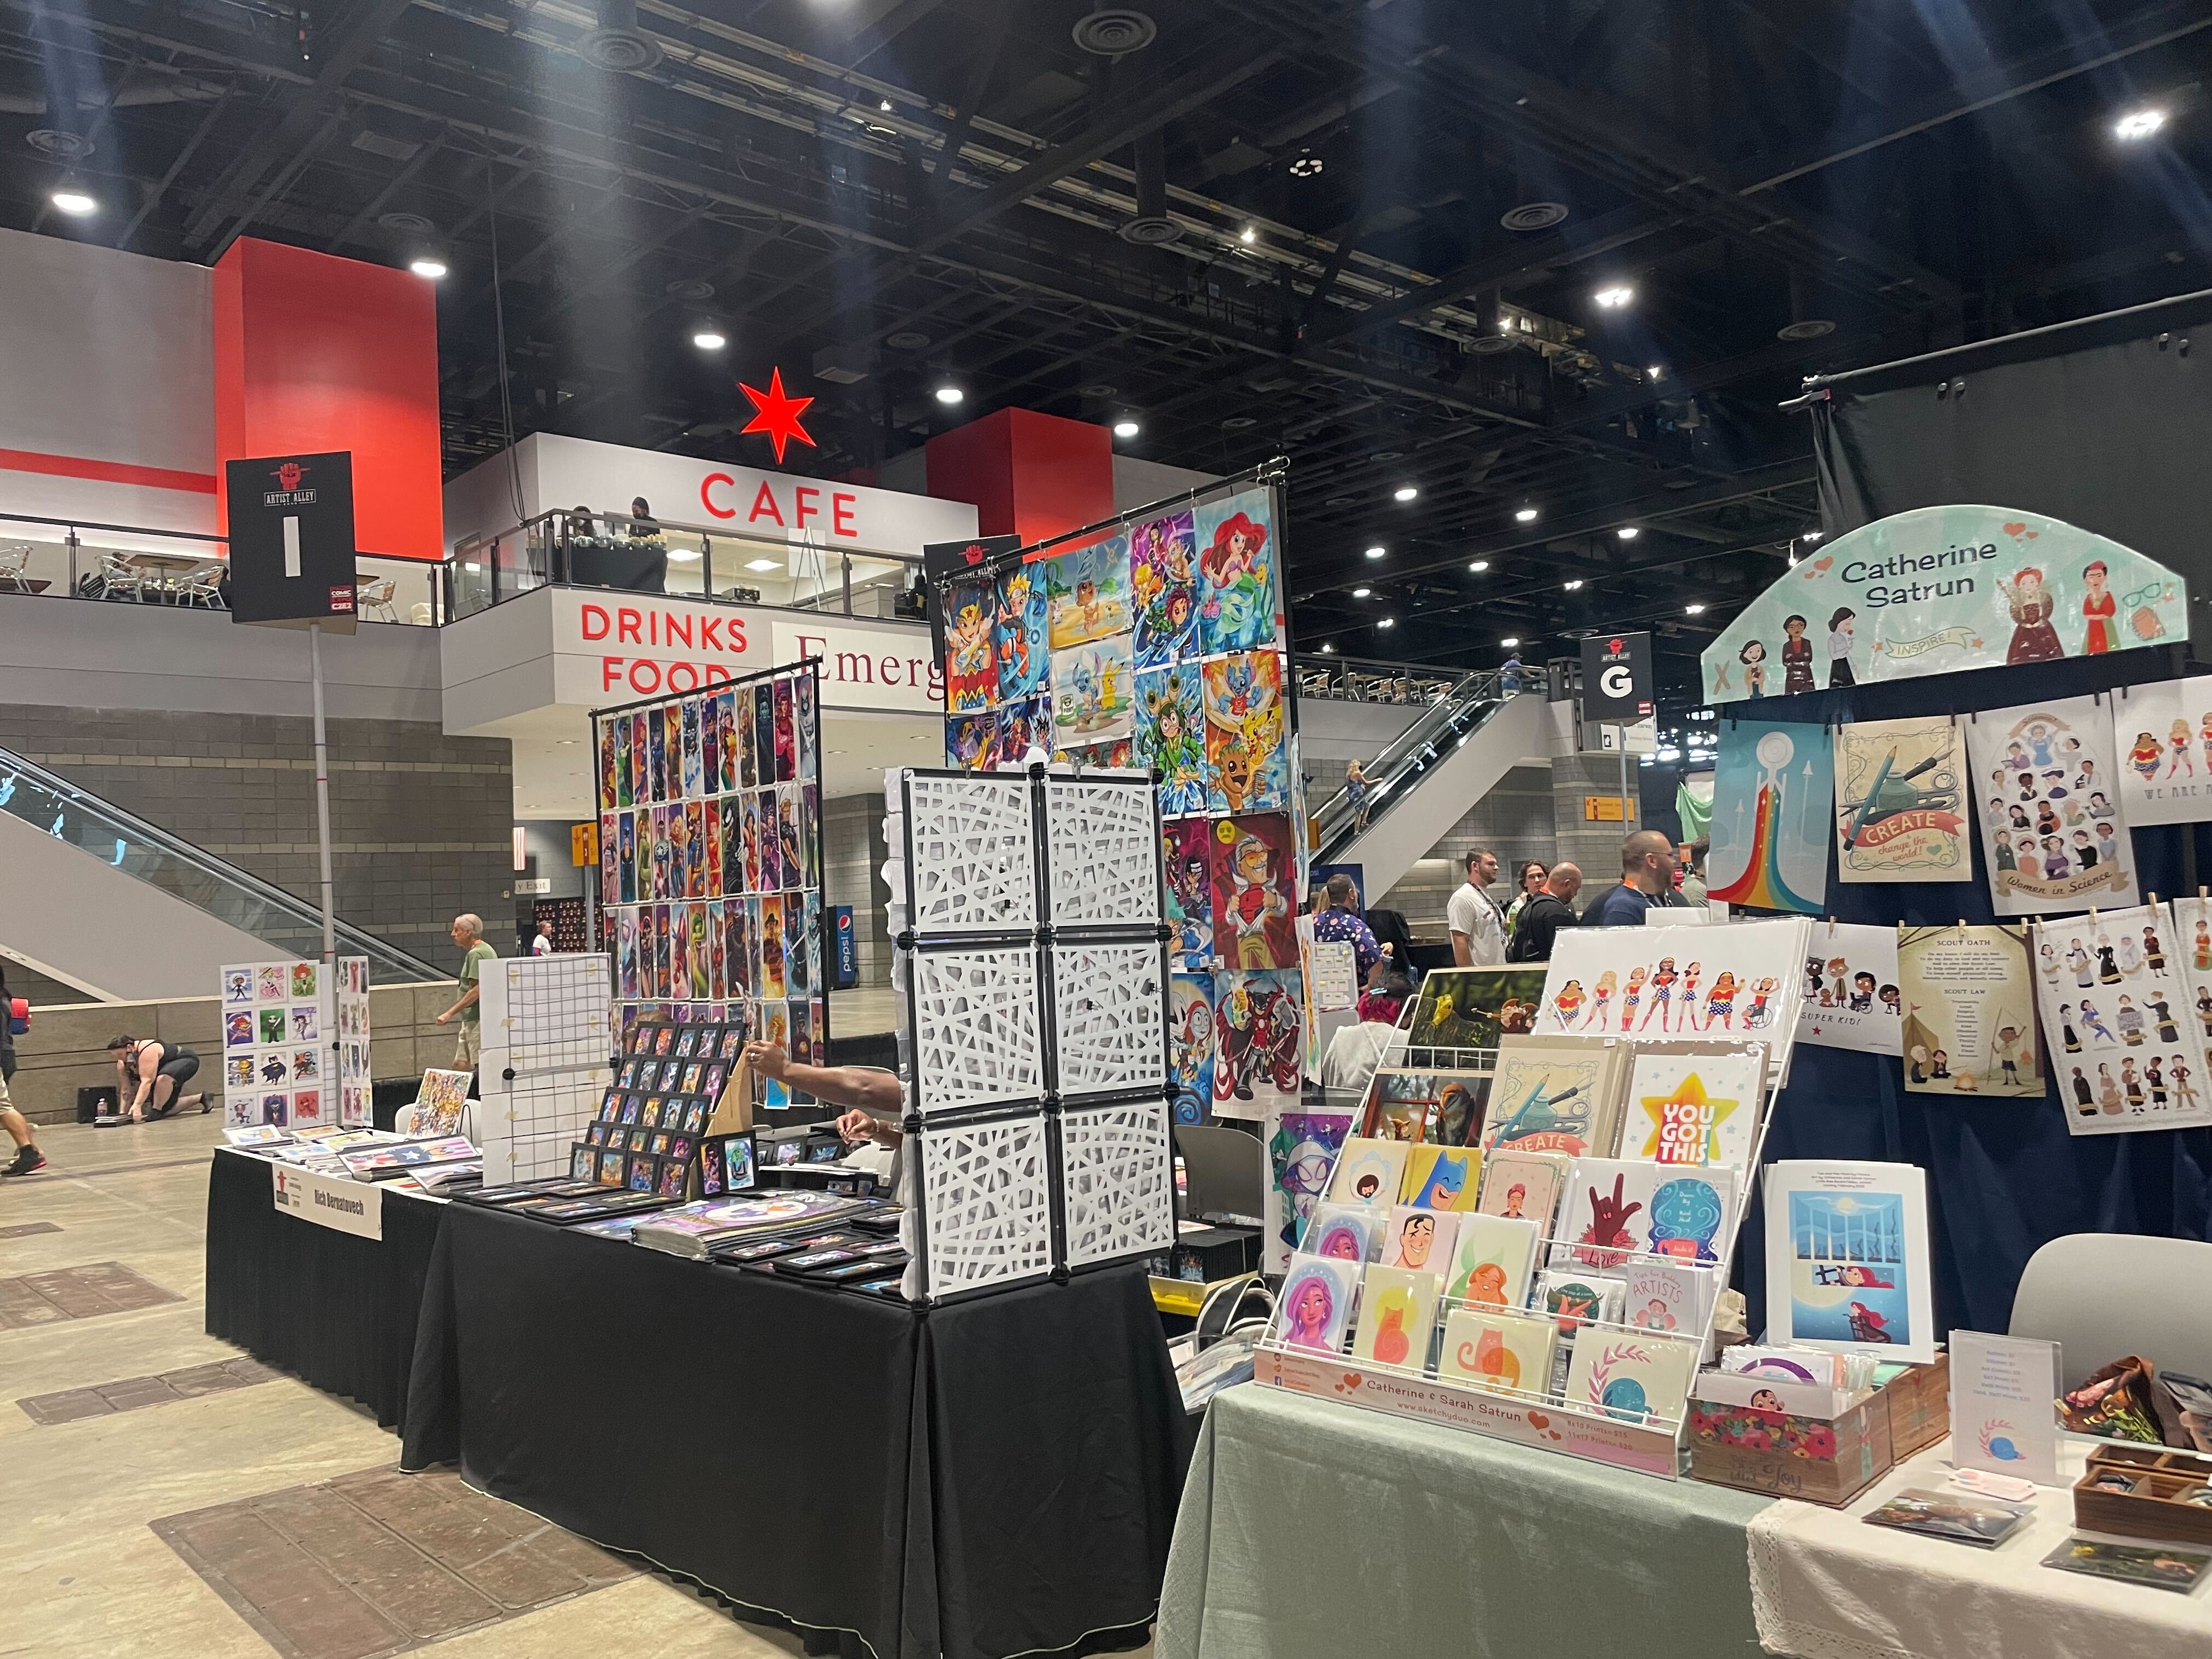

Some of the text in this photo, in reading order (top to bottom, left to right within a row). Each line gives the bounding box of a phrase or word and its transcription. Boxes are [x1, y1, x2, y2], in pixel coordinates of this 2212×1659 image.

[266, 491, 314, 504] ARTIST ALLEY
[701, 473, 857, 537] CAFE
[283, 516, 301, 577] I
[1841, 543, 1997, 583] Catherine
[1866, 577, 1974, 608] Satrun
[582, 605, 747, 653] DRINKS
[603, 656, 731, 697] FOOD
[1600, 665, 1633, 698] G
[2144, 788, 2163, 799] WE
[2172, 785, 2197, 797] ARE
[1865, 812, 1936, 844] CREATE
[1878, 836, 1928, 855] change the
[1893, 845, 1922, 861] world!
[526, 881, 546, 890] Exit
[2007, 871, 2112, 894] Women in Science
[841, 935, 851, 972] pepsi
[1801, 1012, 1833, 1023] SUPER
[1663, 1104, 1715, 1124] YOU
[1661, 1122, 1712, 1143] GOT
[1660, 1141, 1708, 1163] THIS
[1589, 1249, 1620, 1265] Love
[1633, 1280, 1683, 1304] ARTISTS
[1367, 1380, 1424, 1399] Catherine
[1440, 1395, 1474, 1411] Sarah
[1479, 1403, 1521, 1422] Satrun
[1568, 1431, 1588, 1441] 11x17
